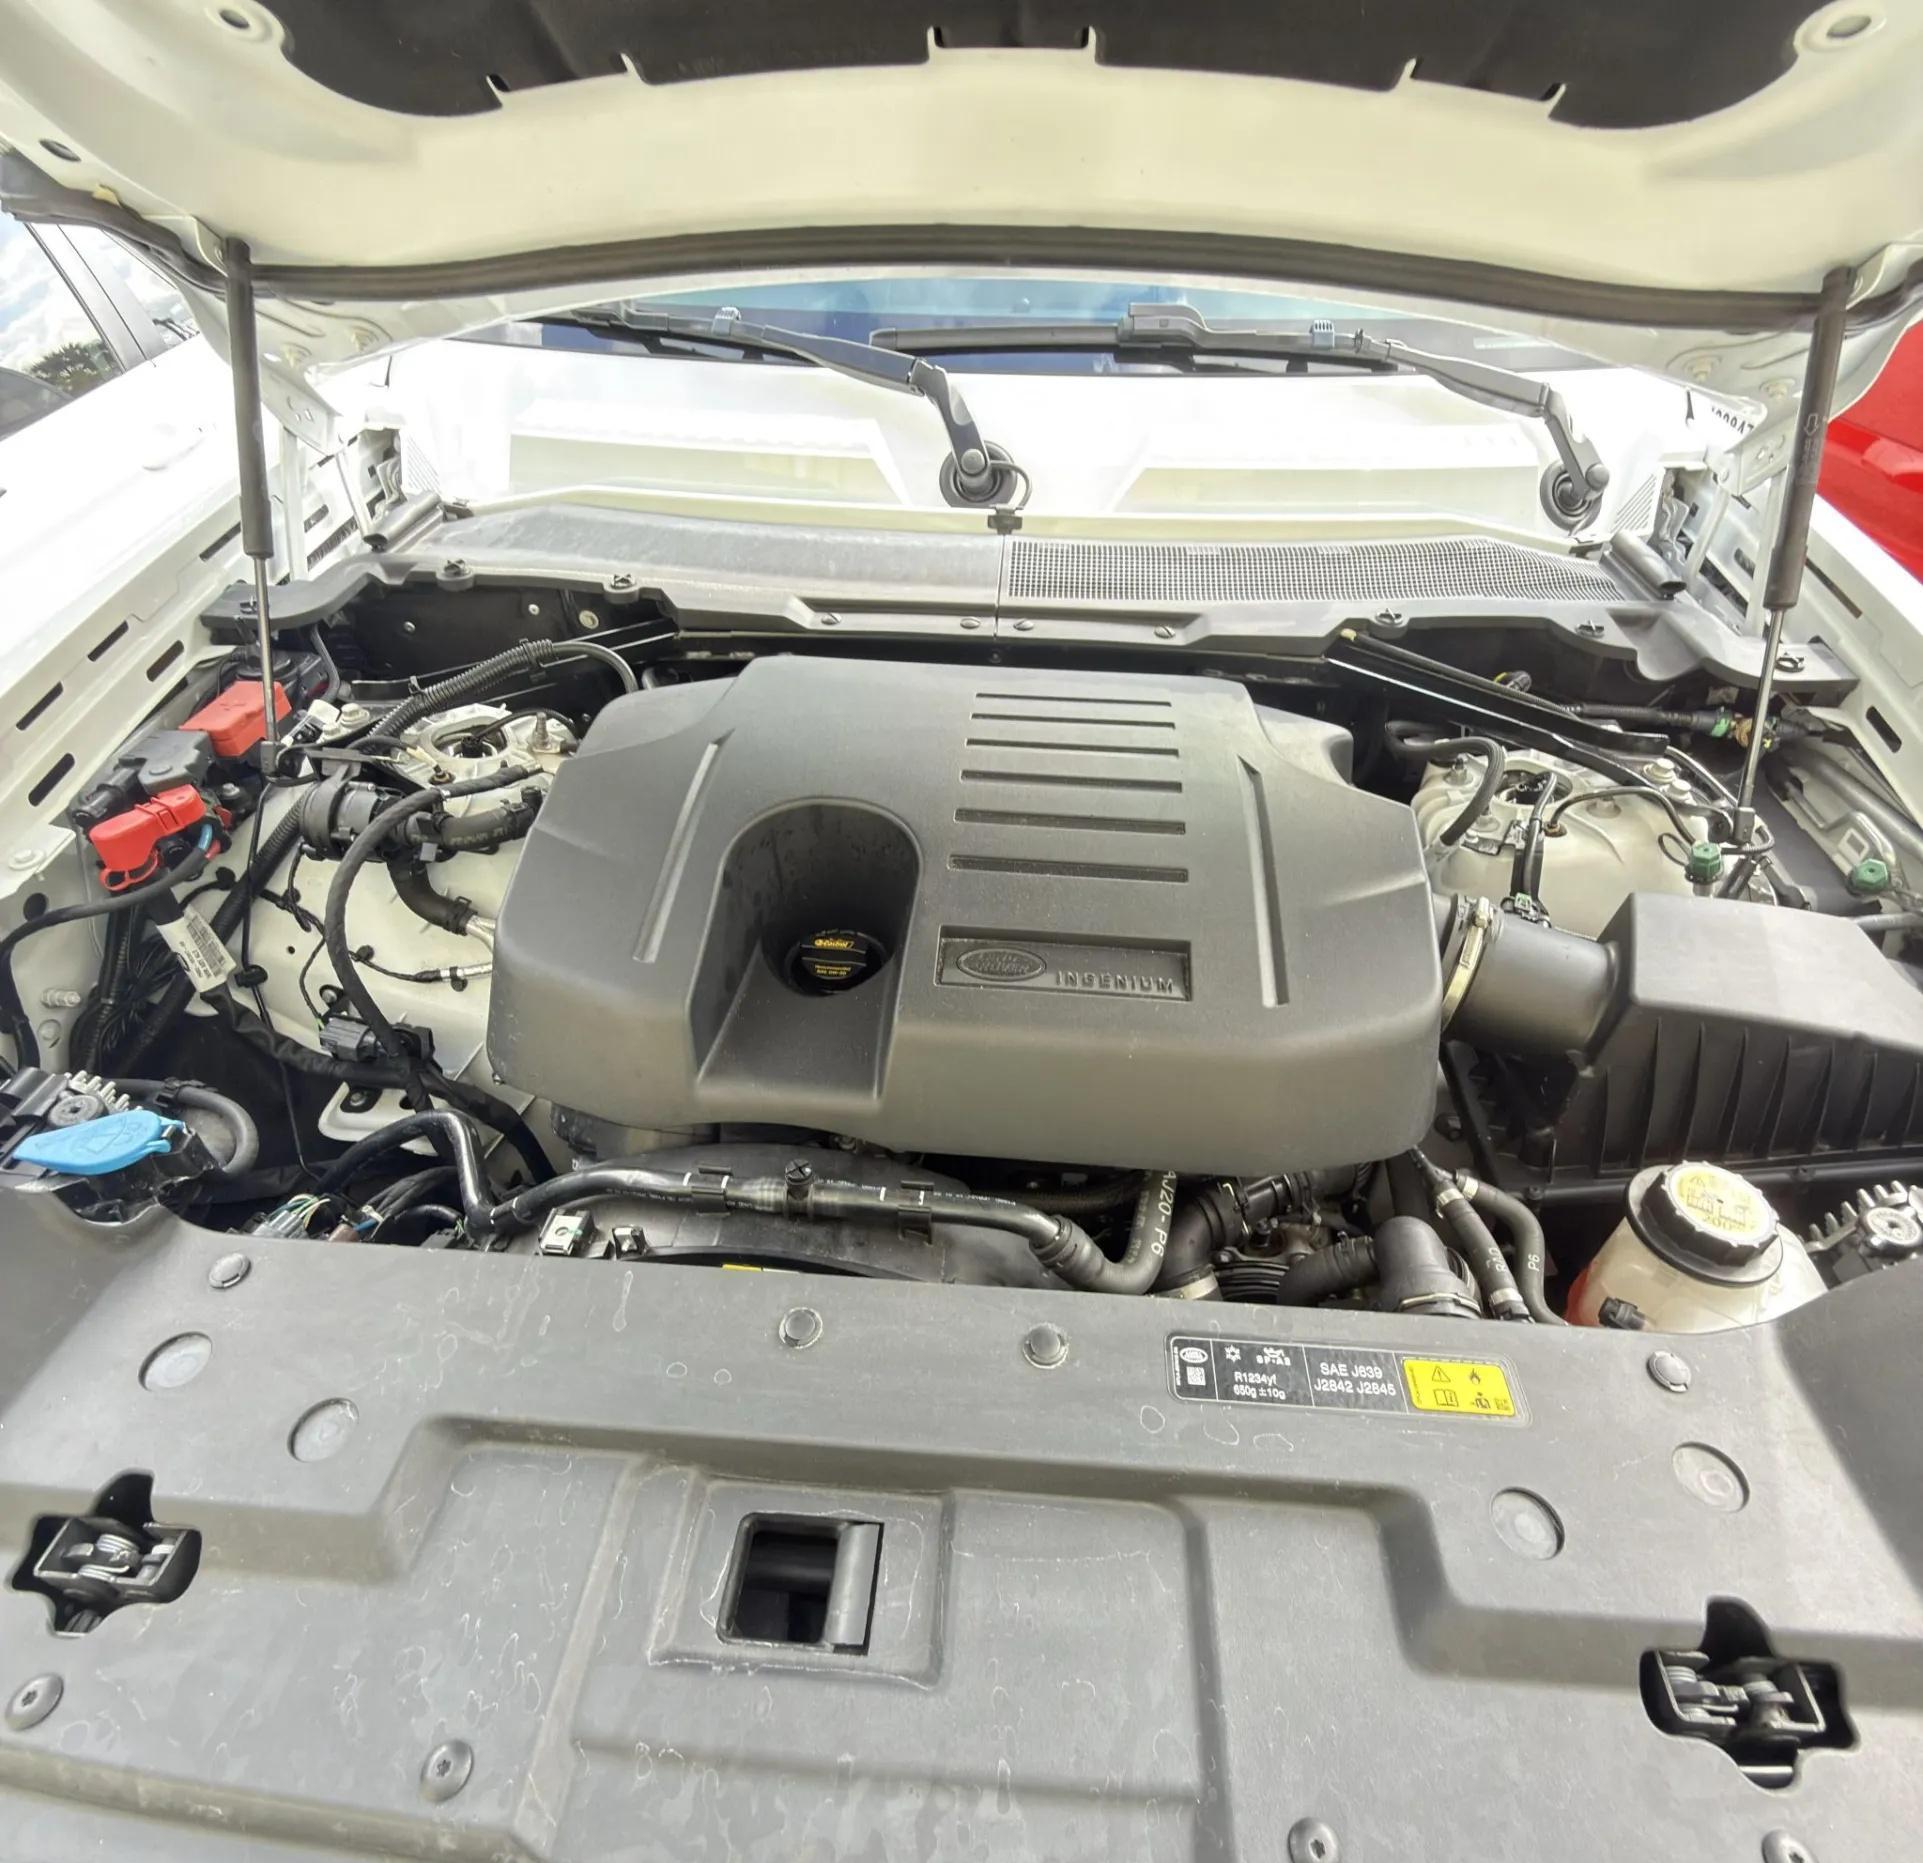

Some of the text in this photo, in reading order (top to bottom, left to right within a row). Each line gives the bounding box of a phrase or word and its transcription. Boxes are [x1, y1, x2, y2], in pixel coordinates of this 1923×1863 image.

[1055, 971, 1174, 994] INGENIUM
[1528, 1253, 1540, 1272] P6
[1320, 1362, 1383, 1379] SAE J639
[1233, 1384, 1257, 1399] 650g
[1314, 1378, 1396, 1396] J2842 J2845
